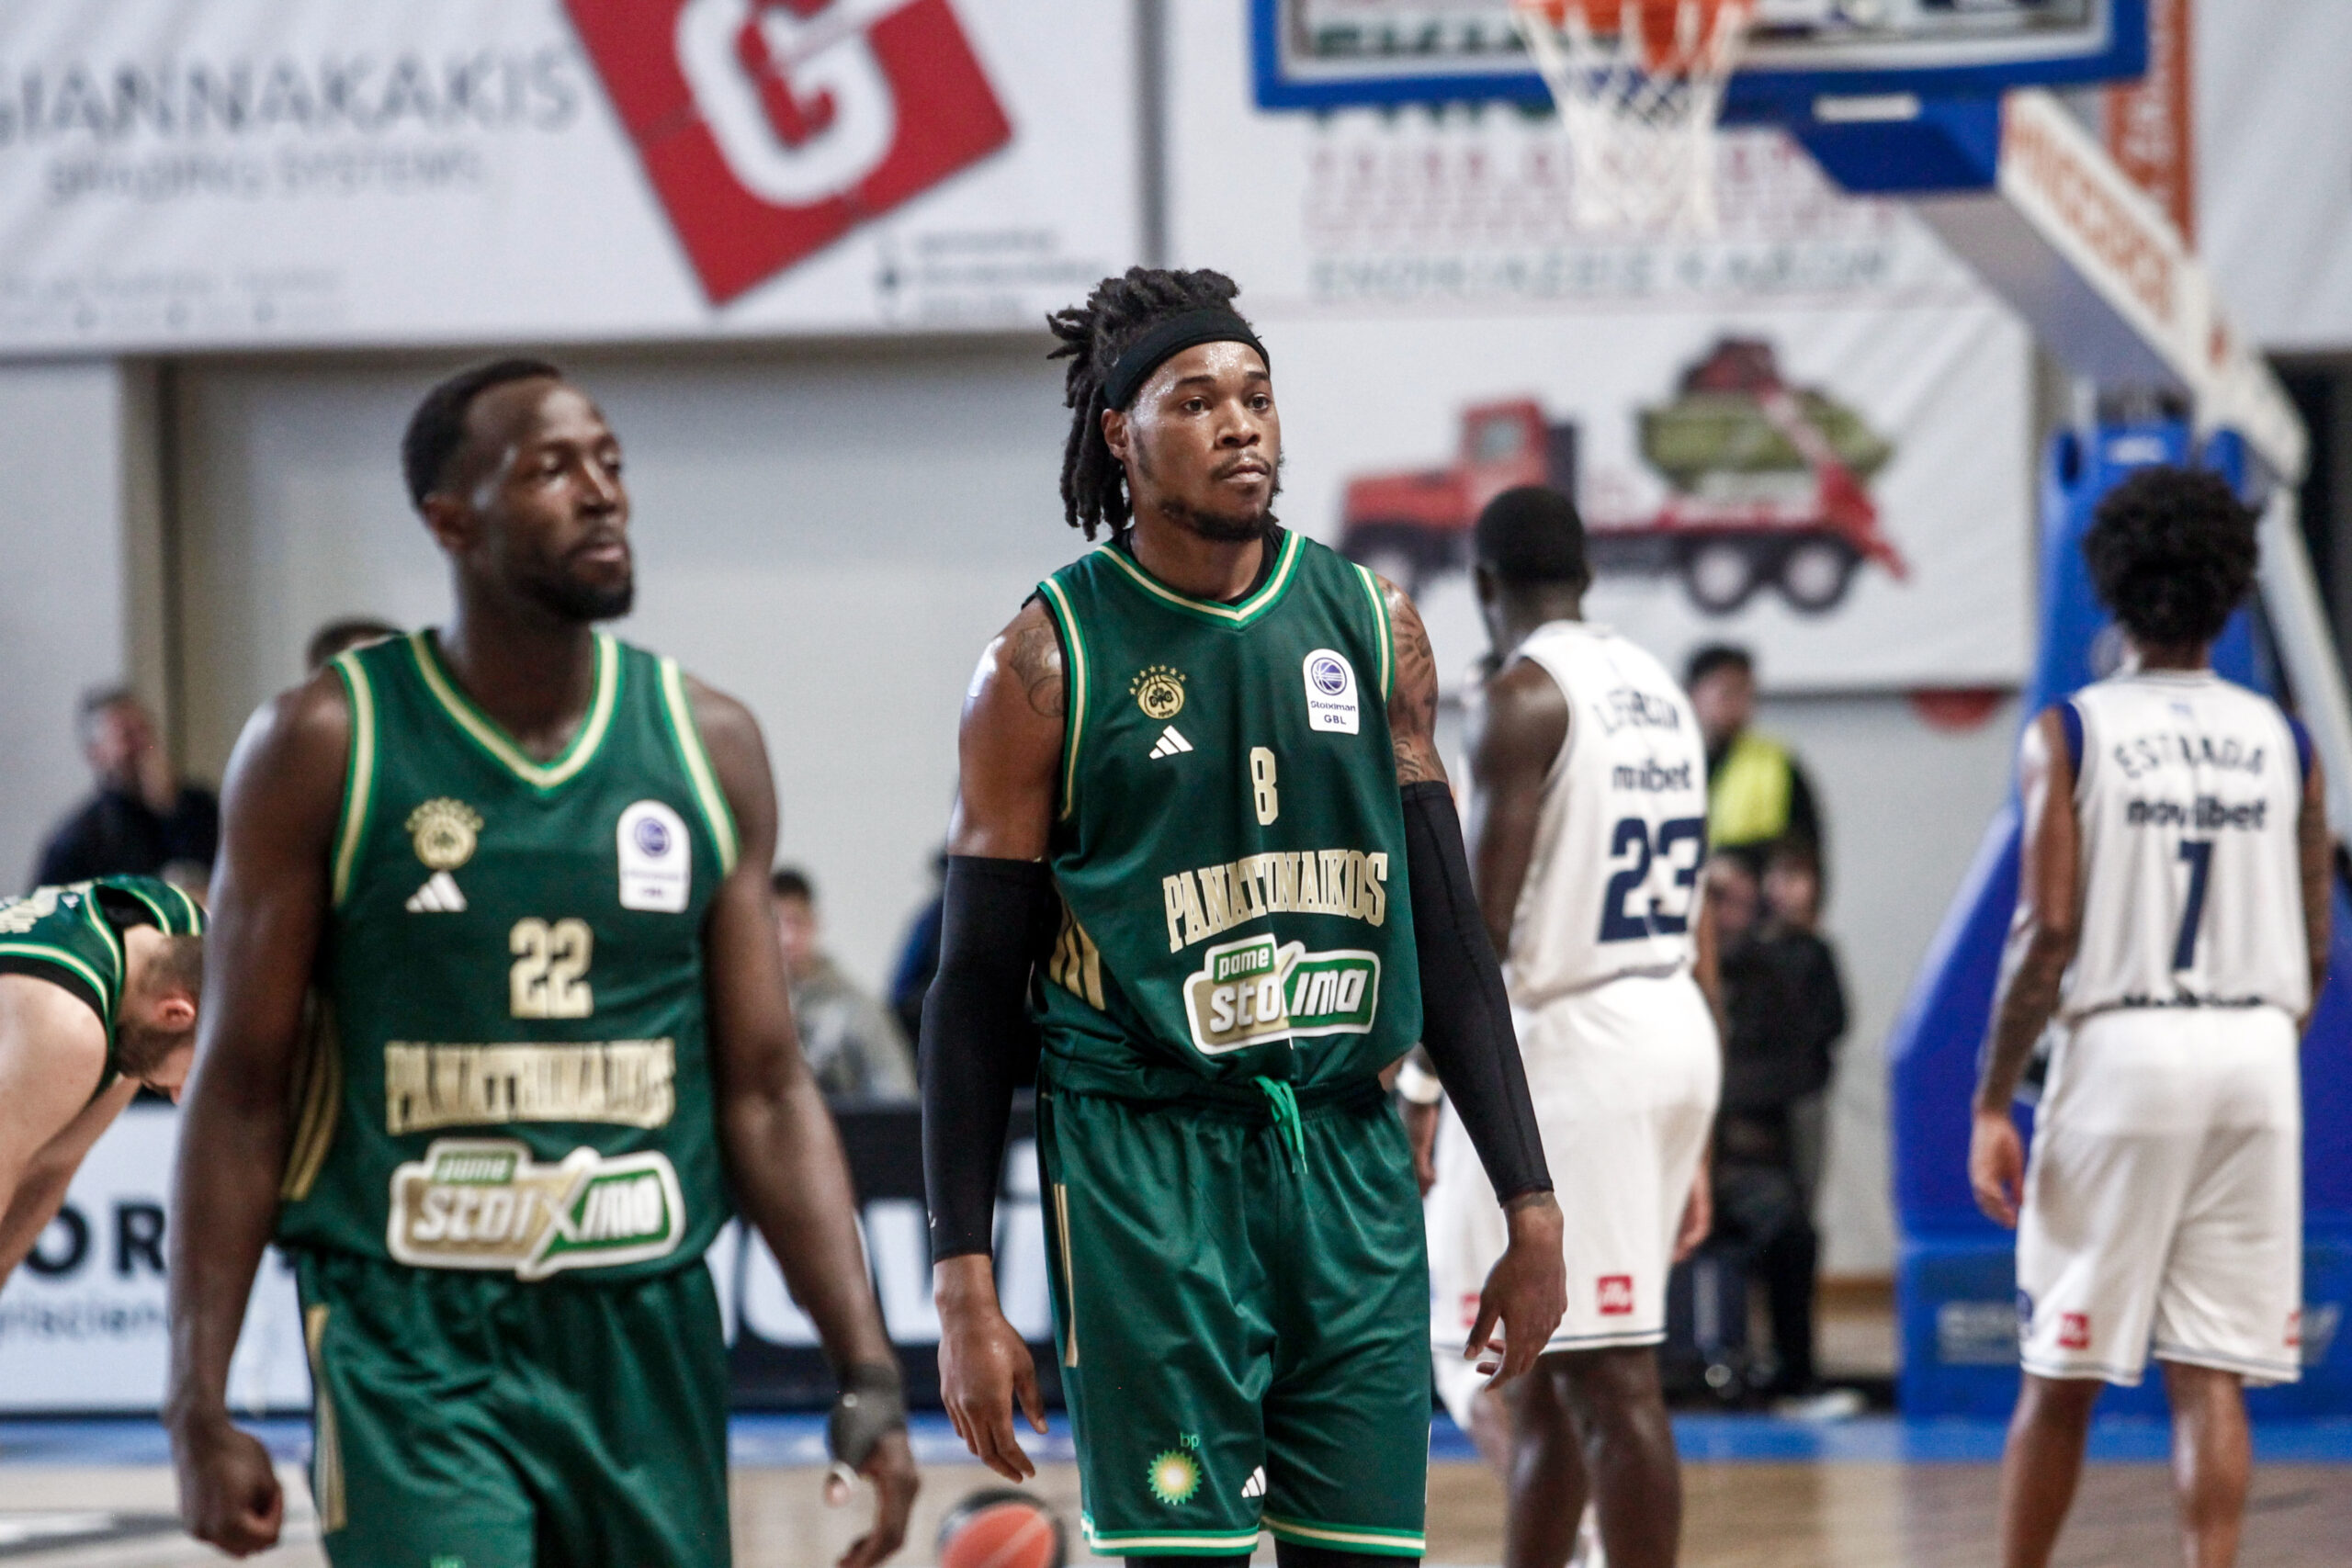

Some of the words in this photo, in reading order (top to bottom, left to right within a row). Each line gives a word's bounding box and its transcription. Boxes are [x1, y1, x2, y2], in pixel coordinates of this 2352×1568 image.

[1310, 700, 1356, 712] Stoiximan
[1324, 714, 1347, 726] GBL
[1250, 746, 1279, 826] 8
[1162, 849, 1388, 953] PANATINAIKOS
[1598, 816, 1707, 942] 23
[2172, 838, 2211, 971] 7
[509, 917, 595, 1020] 22
[1218, 947, 1270, 981] pame
[1180, 1432, 1200, 1451] bp
